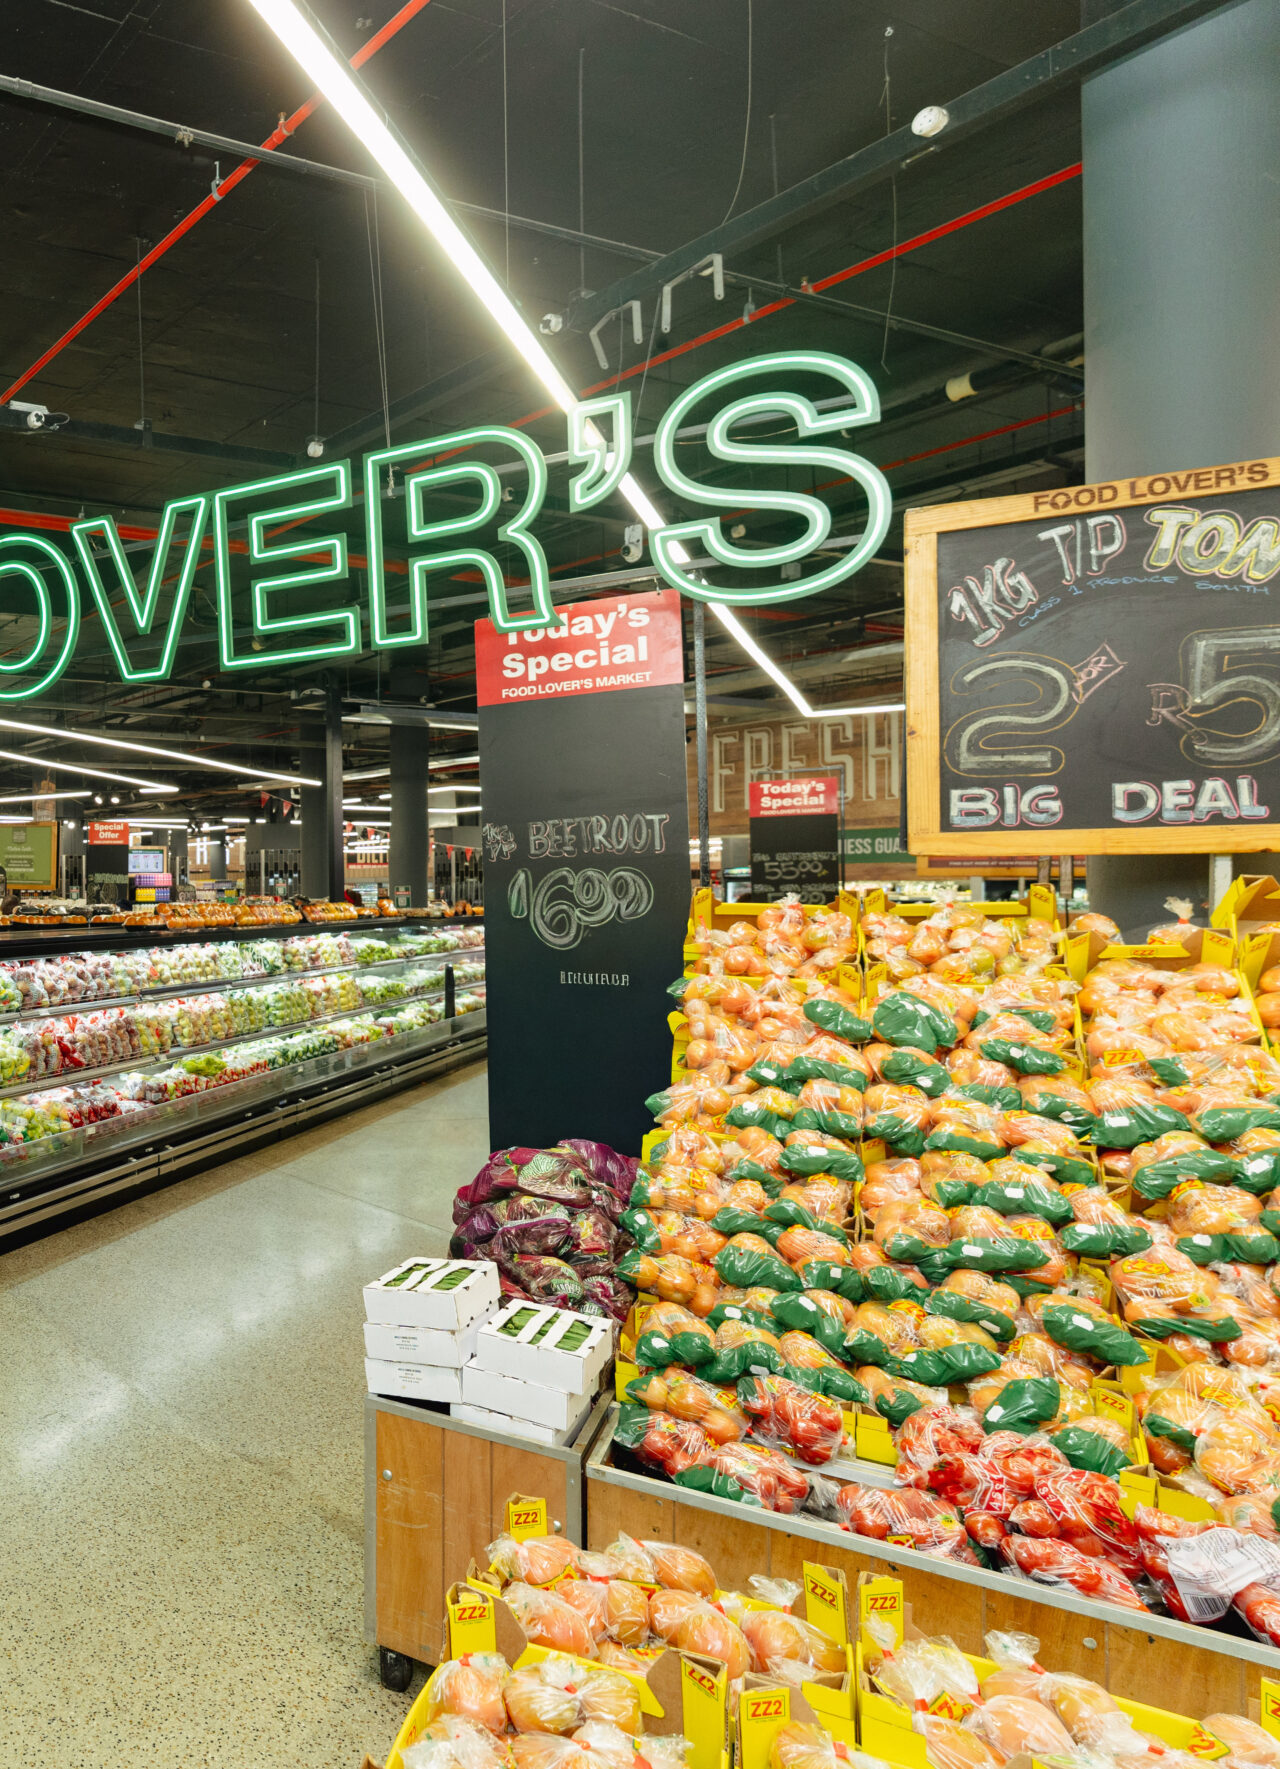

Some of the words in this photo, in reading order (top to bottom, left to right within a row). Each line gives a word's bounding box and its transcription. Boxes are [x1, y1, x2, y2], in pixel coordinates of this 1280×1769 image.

[1033, 484, 1118, 513] FOOD
[1129, 462, 1270, 500] LOVER'S
[1018, 596, 1062, 627] CLASS
[1067, 584, 1084, 596] 1
[1086, 575, 1179, 590] PRODUCE
[1193, 580, 1271, 595] SOUTH
[501, 635, 649, 682] Special
[501, 687, 537, 699] FOOD
[538, 677, 593, 694] LOVER'S
[595, 671, 653, 688] MARKET
[943, 651, 1083, 778] 2
[712, 708, 901, 813] FRESH
[760, 780, 826, 795] Today's
[760, 794, 825, 809] Special
[949, 783, 1063, 828] BIG
[1111, 775, 1270, 824] DEAL
[94, 824, 124, 832] Special
[528, 813, 670, 859] BEETROOT
[1101, 1393, 1126, 1413] ZZ2
[514, 1511, 538, 1525] ZZ2
[810, 1579, 837, 1607] ZZ2
[870, 1596, 897, 1610] ZZ2
[457, 1606, 487, 1621] ZZ2
[751, 1700, 783, 1718] ZZ2
